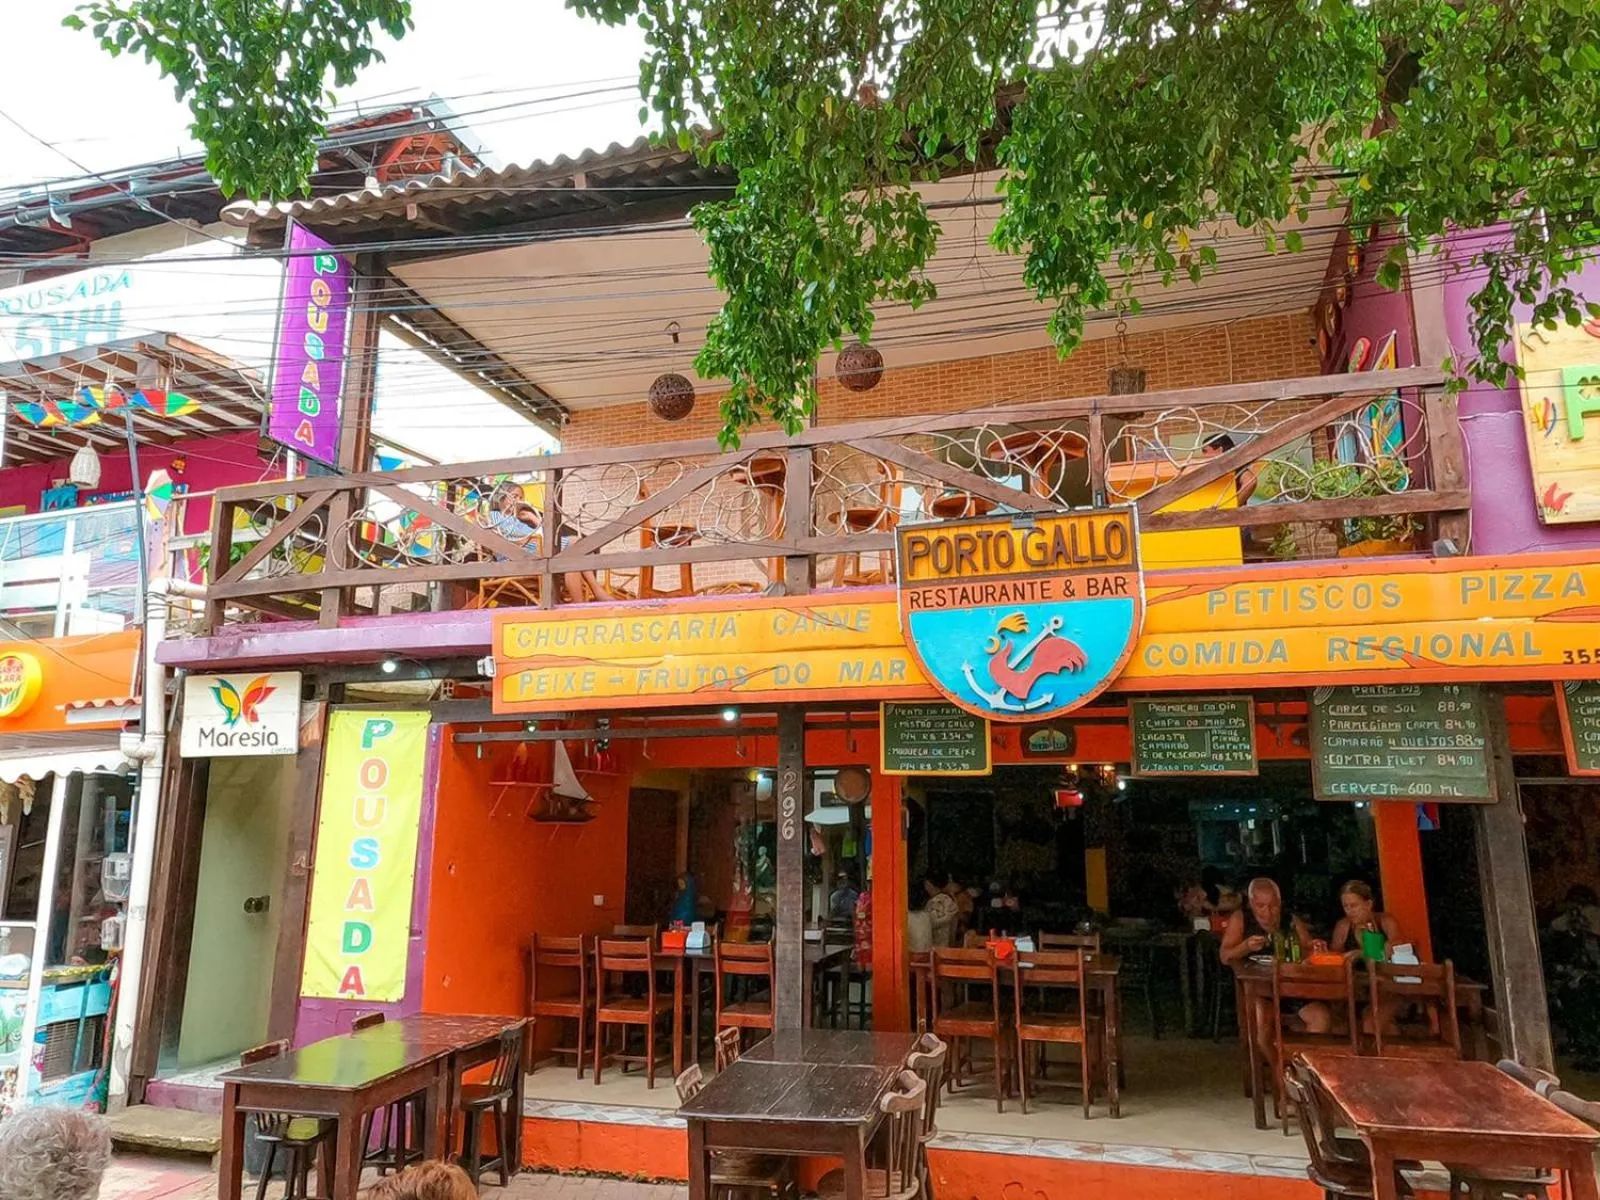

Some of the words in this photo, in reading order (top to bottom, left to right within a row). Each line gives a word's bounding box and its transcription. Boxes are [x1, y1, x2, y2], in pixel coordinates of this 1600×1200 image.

[0, 269, 131, 314] OUSADA
[295, 249, 339, 448] POUSADA
[907, 529, 1014, 577] PORTO
[1022, 520, 1129, 567] GALLO
[909, 579, 1053, 609] RESTAURANTE
[1062, 579, 1076, 597] &
[1086, 575, 1129, 597] BAR
[1206, 581, 1403, 617] PETISCOS
[1460, 571, 1587, 606] PIZZA
[516, 616, 738, 649] CHURRASCARIA
[772, 608, 871, 635] CARNE
[1143, 637, 1289, 668] COMIDA
[1326, 630, 1543, 663] REGIONAL
[518, 671, 596, 696] PEIXE
[636, 661, 749, 694] FRUTOS
[773, 661, 811, 687] DO
[837, 657, 908, 683] MAR
[1373, 704, 1388, 713] DE
[1393, 704, 1417, 713] SOL
[198, 725, 279, 748] Maresia
[1388, 737, 1397, 747] 4
[1400, 735, 1454, 747] QUEIJOS
[1387, 755, 1426, 766] FILET
[781, 770, 798, 841] 296
[1407, 783, 1432, 795] 600
[1440, 784, 1464, 796] ML
[337, 719, 394, 996] POUSADA
